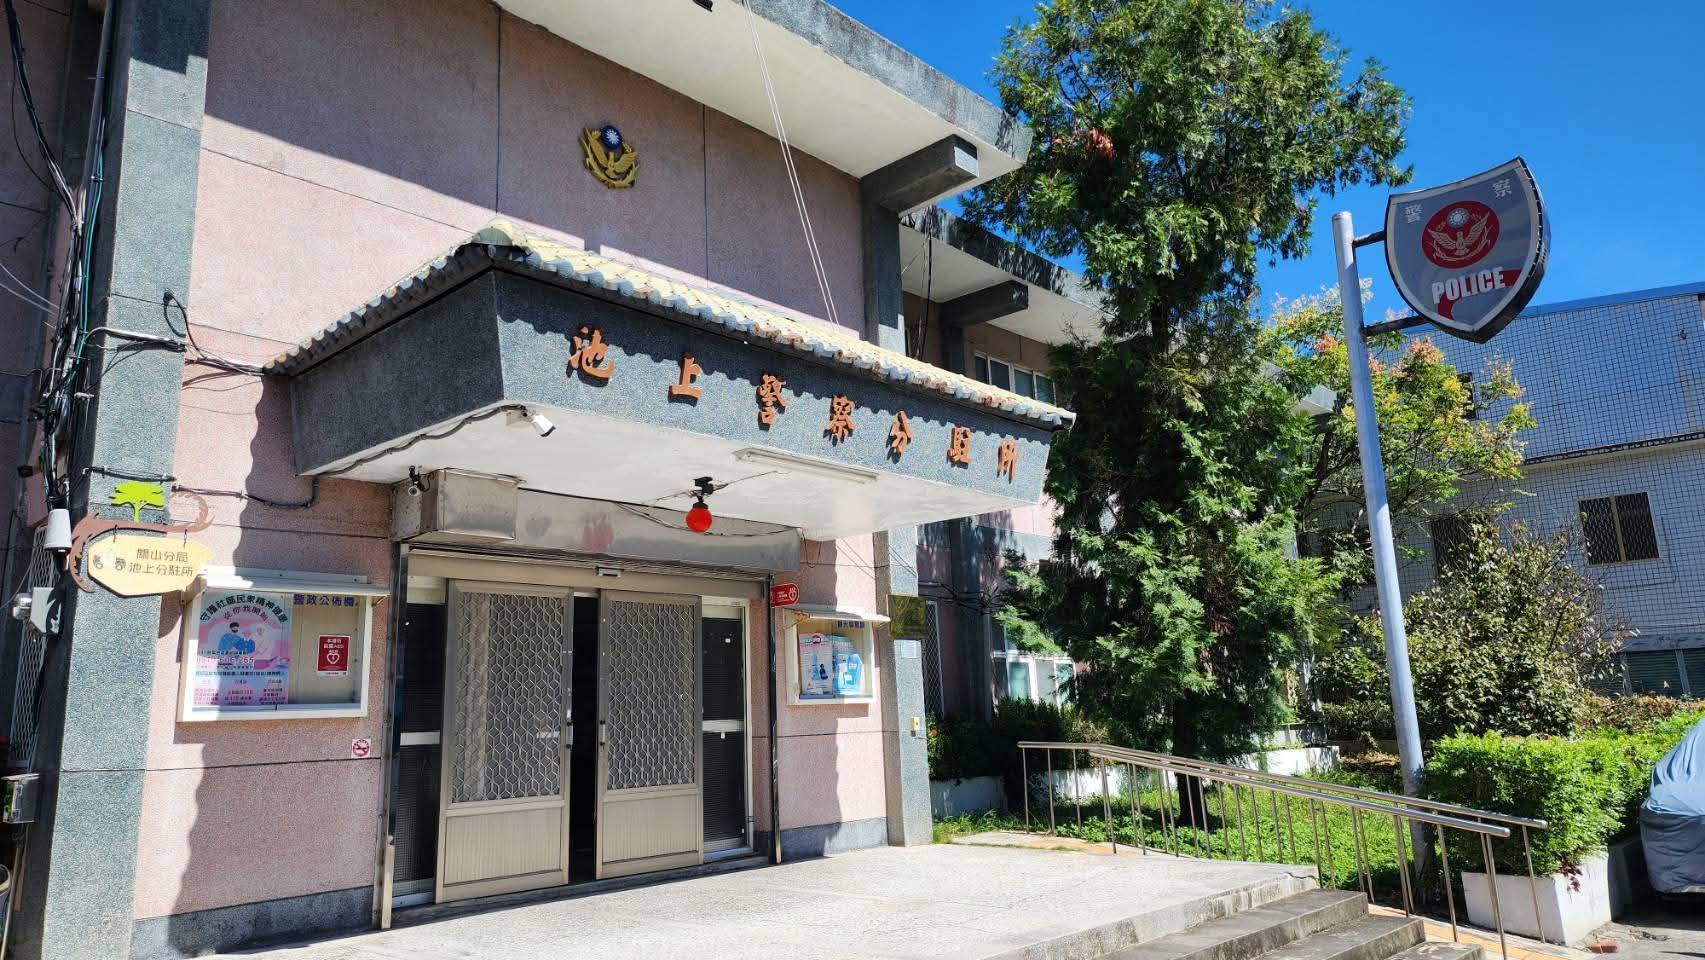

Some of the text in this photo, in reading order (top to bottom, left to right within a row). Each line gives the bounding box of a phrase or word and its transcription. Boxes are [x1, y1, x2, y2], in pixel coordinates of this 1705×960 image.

[1431, 267, 1506, 304] POLICE
[568, 325, 1019, 482] 池上警察分駐所
[136, 548, 189, 562] 關山分局
[129, 562, 193, 577] 池上分駐所
